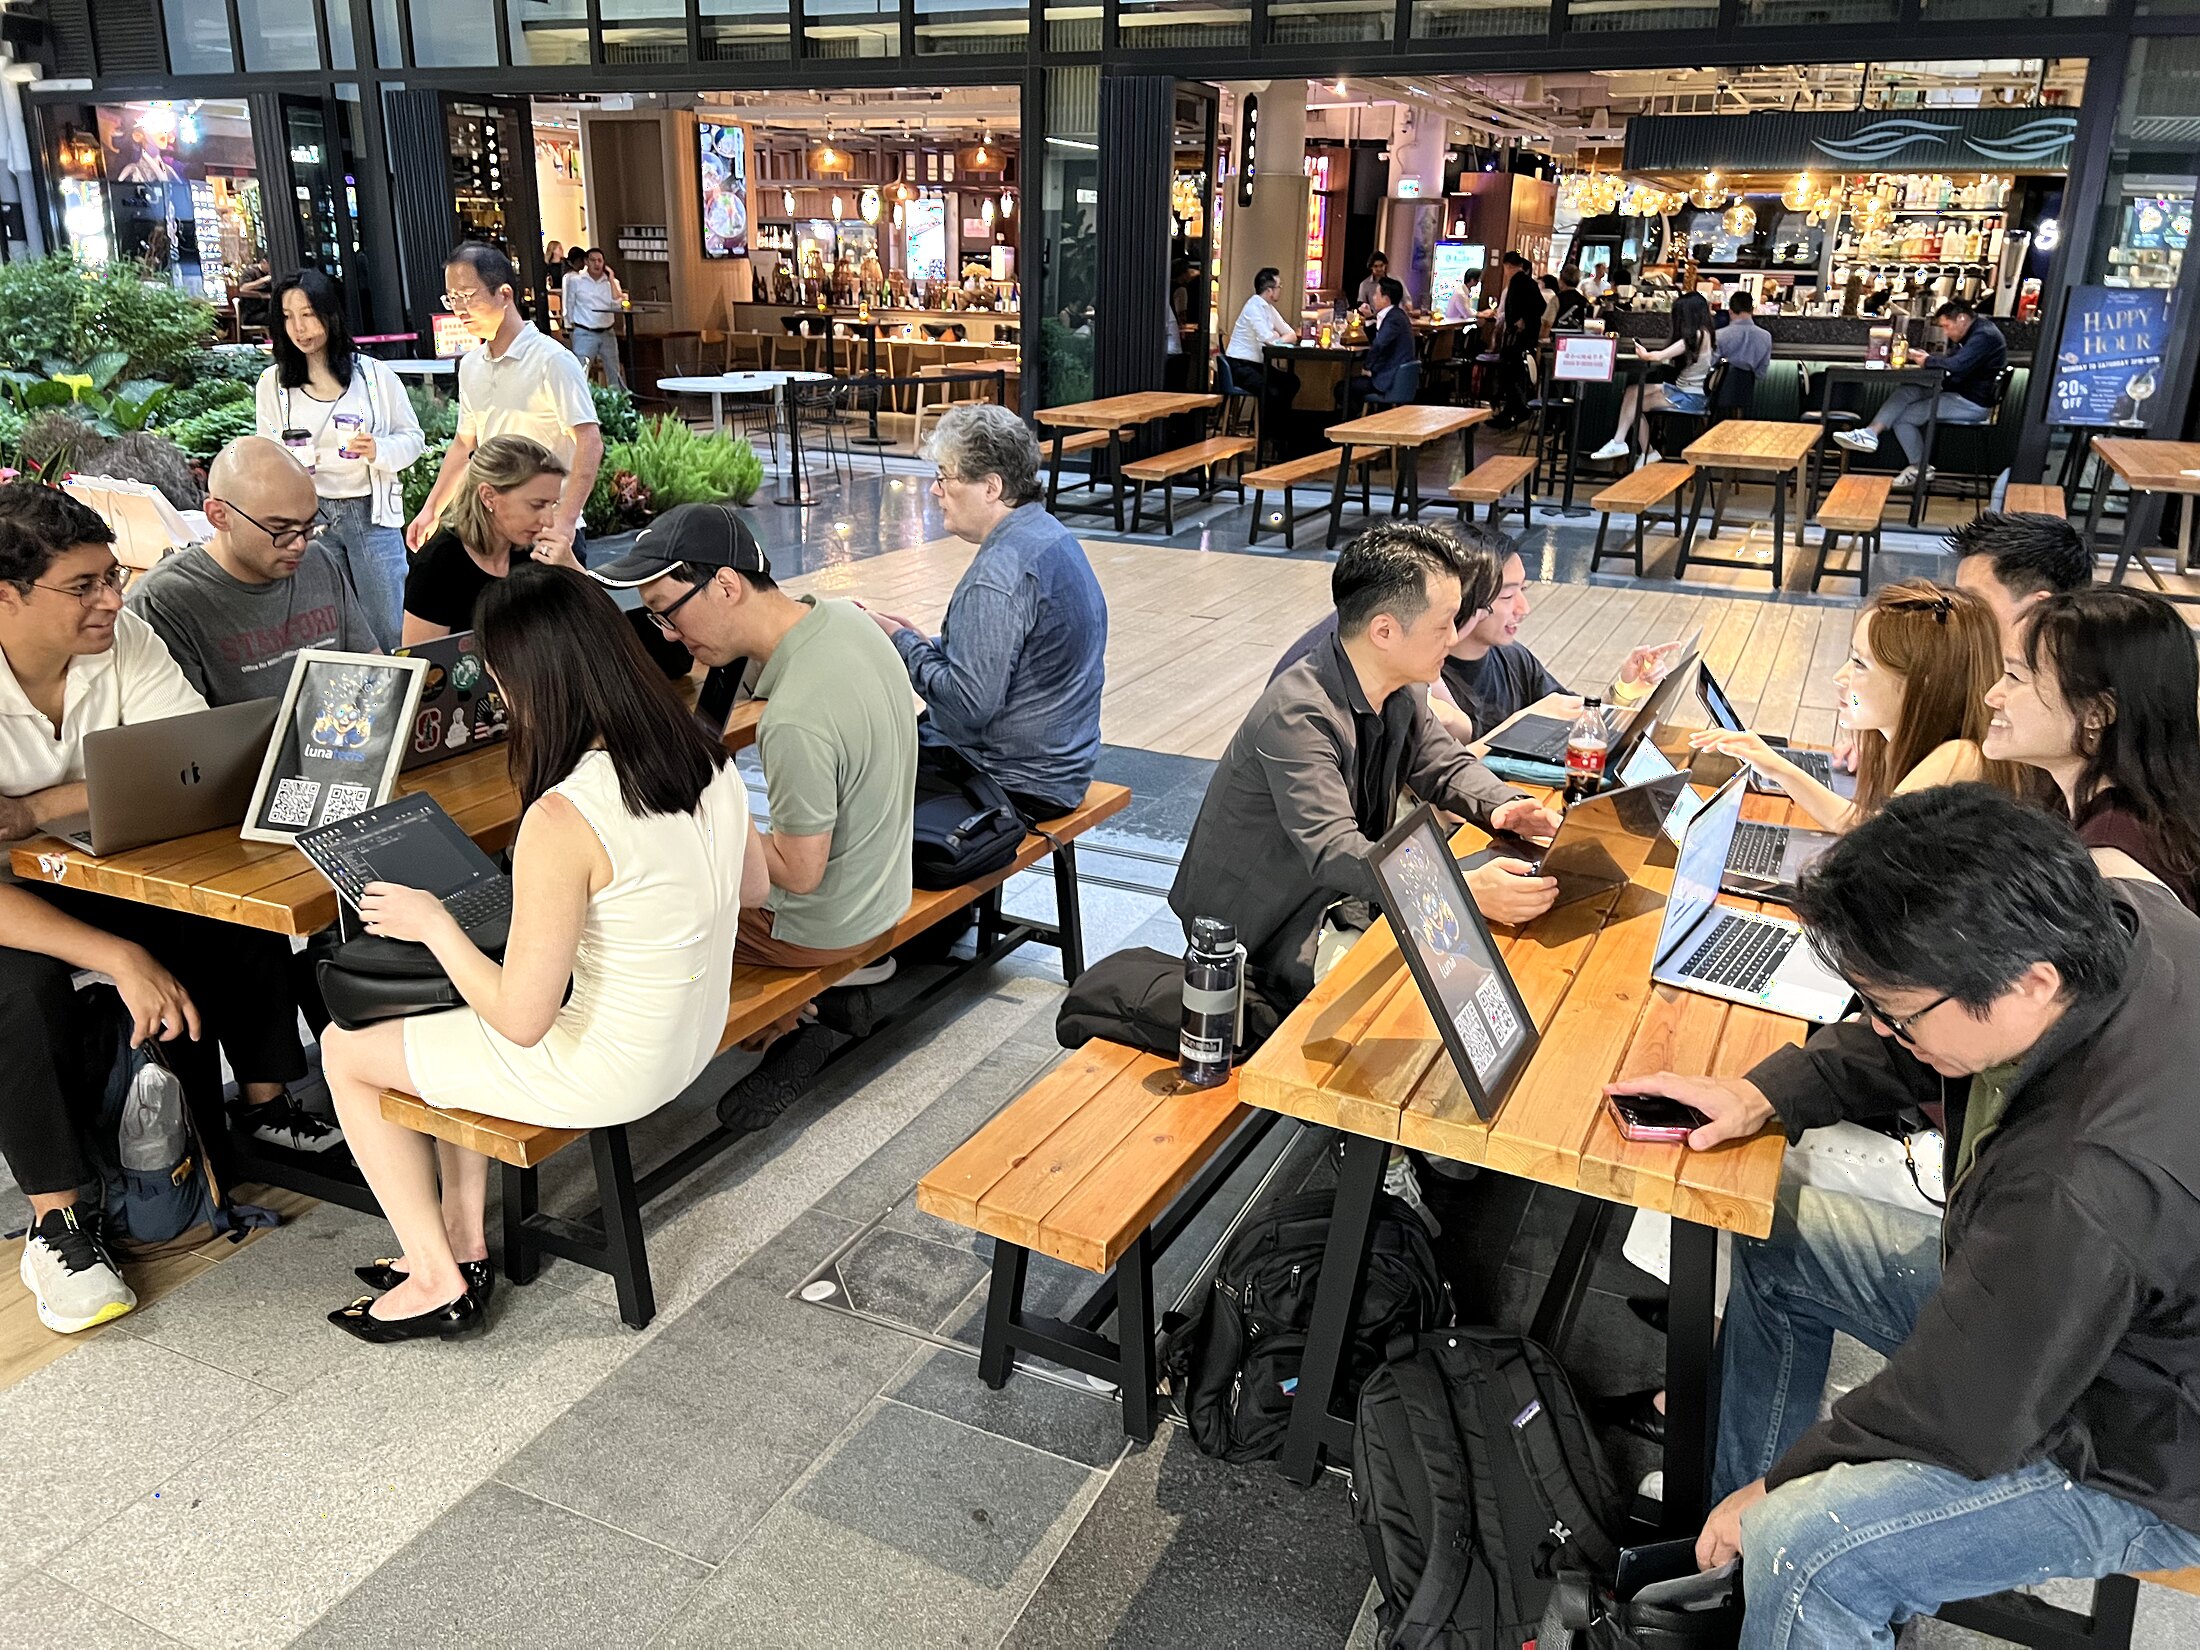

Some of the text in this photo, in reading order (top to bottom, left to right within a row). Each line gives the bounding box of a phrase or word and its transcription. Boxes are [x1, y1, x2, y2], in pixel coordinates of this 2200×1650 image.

[2083, 308, 2152, 333] HAPPY
[2083, 333, 2150, 355] HOUR
[2058, 380, 2088, 397] 20%
[2062, 397, 2082, 409] OFF
